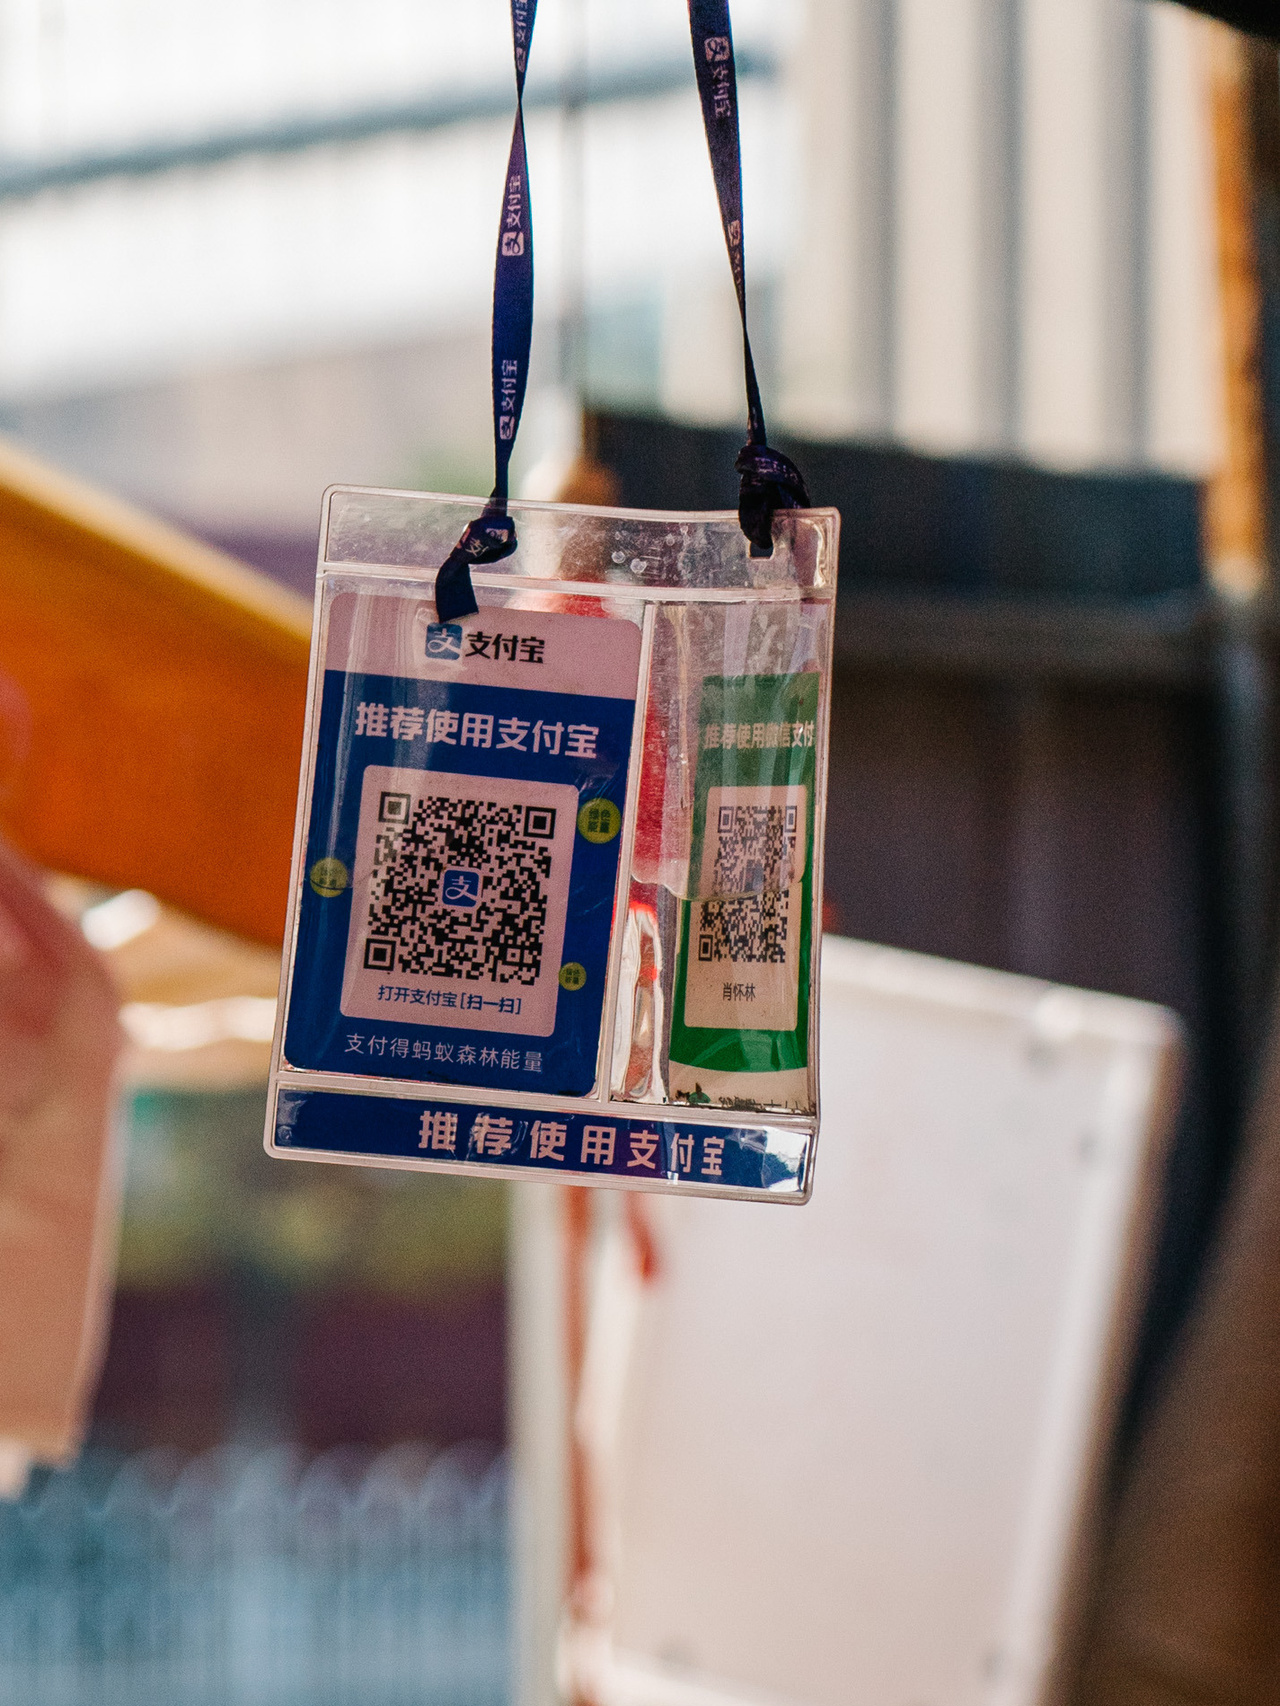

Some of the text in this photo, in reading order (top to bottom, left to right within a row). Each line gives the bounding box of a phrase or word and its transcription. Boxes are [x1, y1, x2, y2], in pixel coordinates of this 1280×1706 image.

[506, 175, 521, 229] 支付宝
[501, 359, 517, 413] 支付宝
[465, 631, 545, 664] 支付宝
[355, 702, 600, 759] 推荐使用支付宝
[723, 982, 756, 1001] 肖怀林
[344, 1033, 543, 1073] 支付得蚂蚁森林能量
[418, 1110, 725, 1176] 推荐使用支付宝
